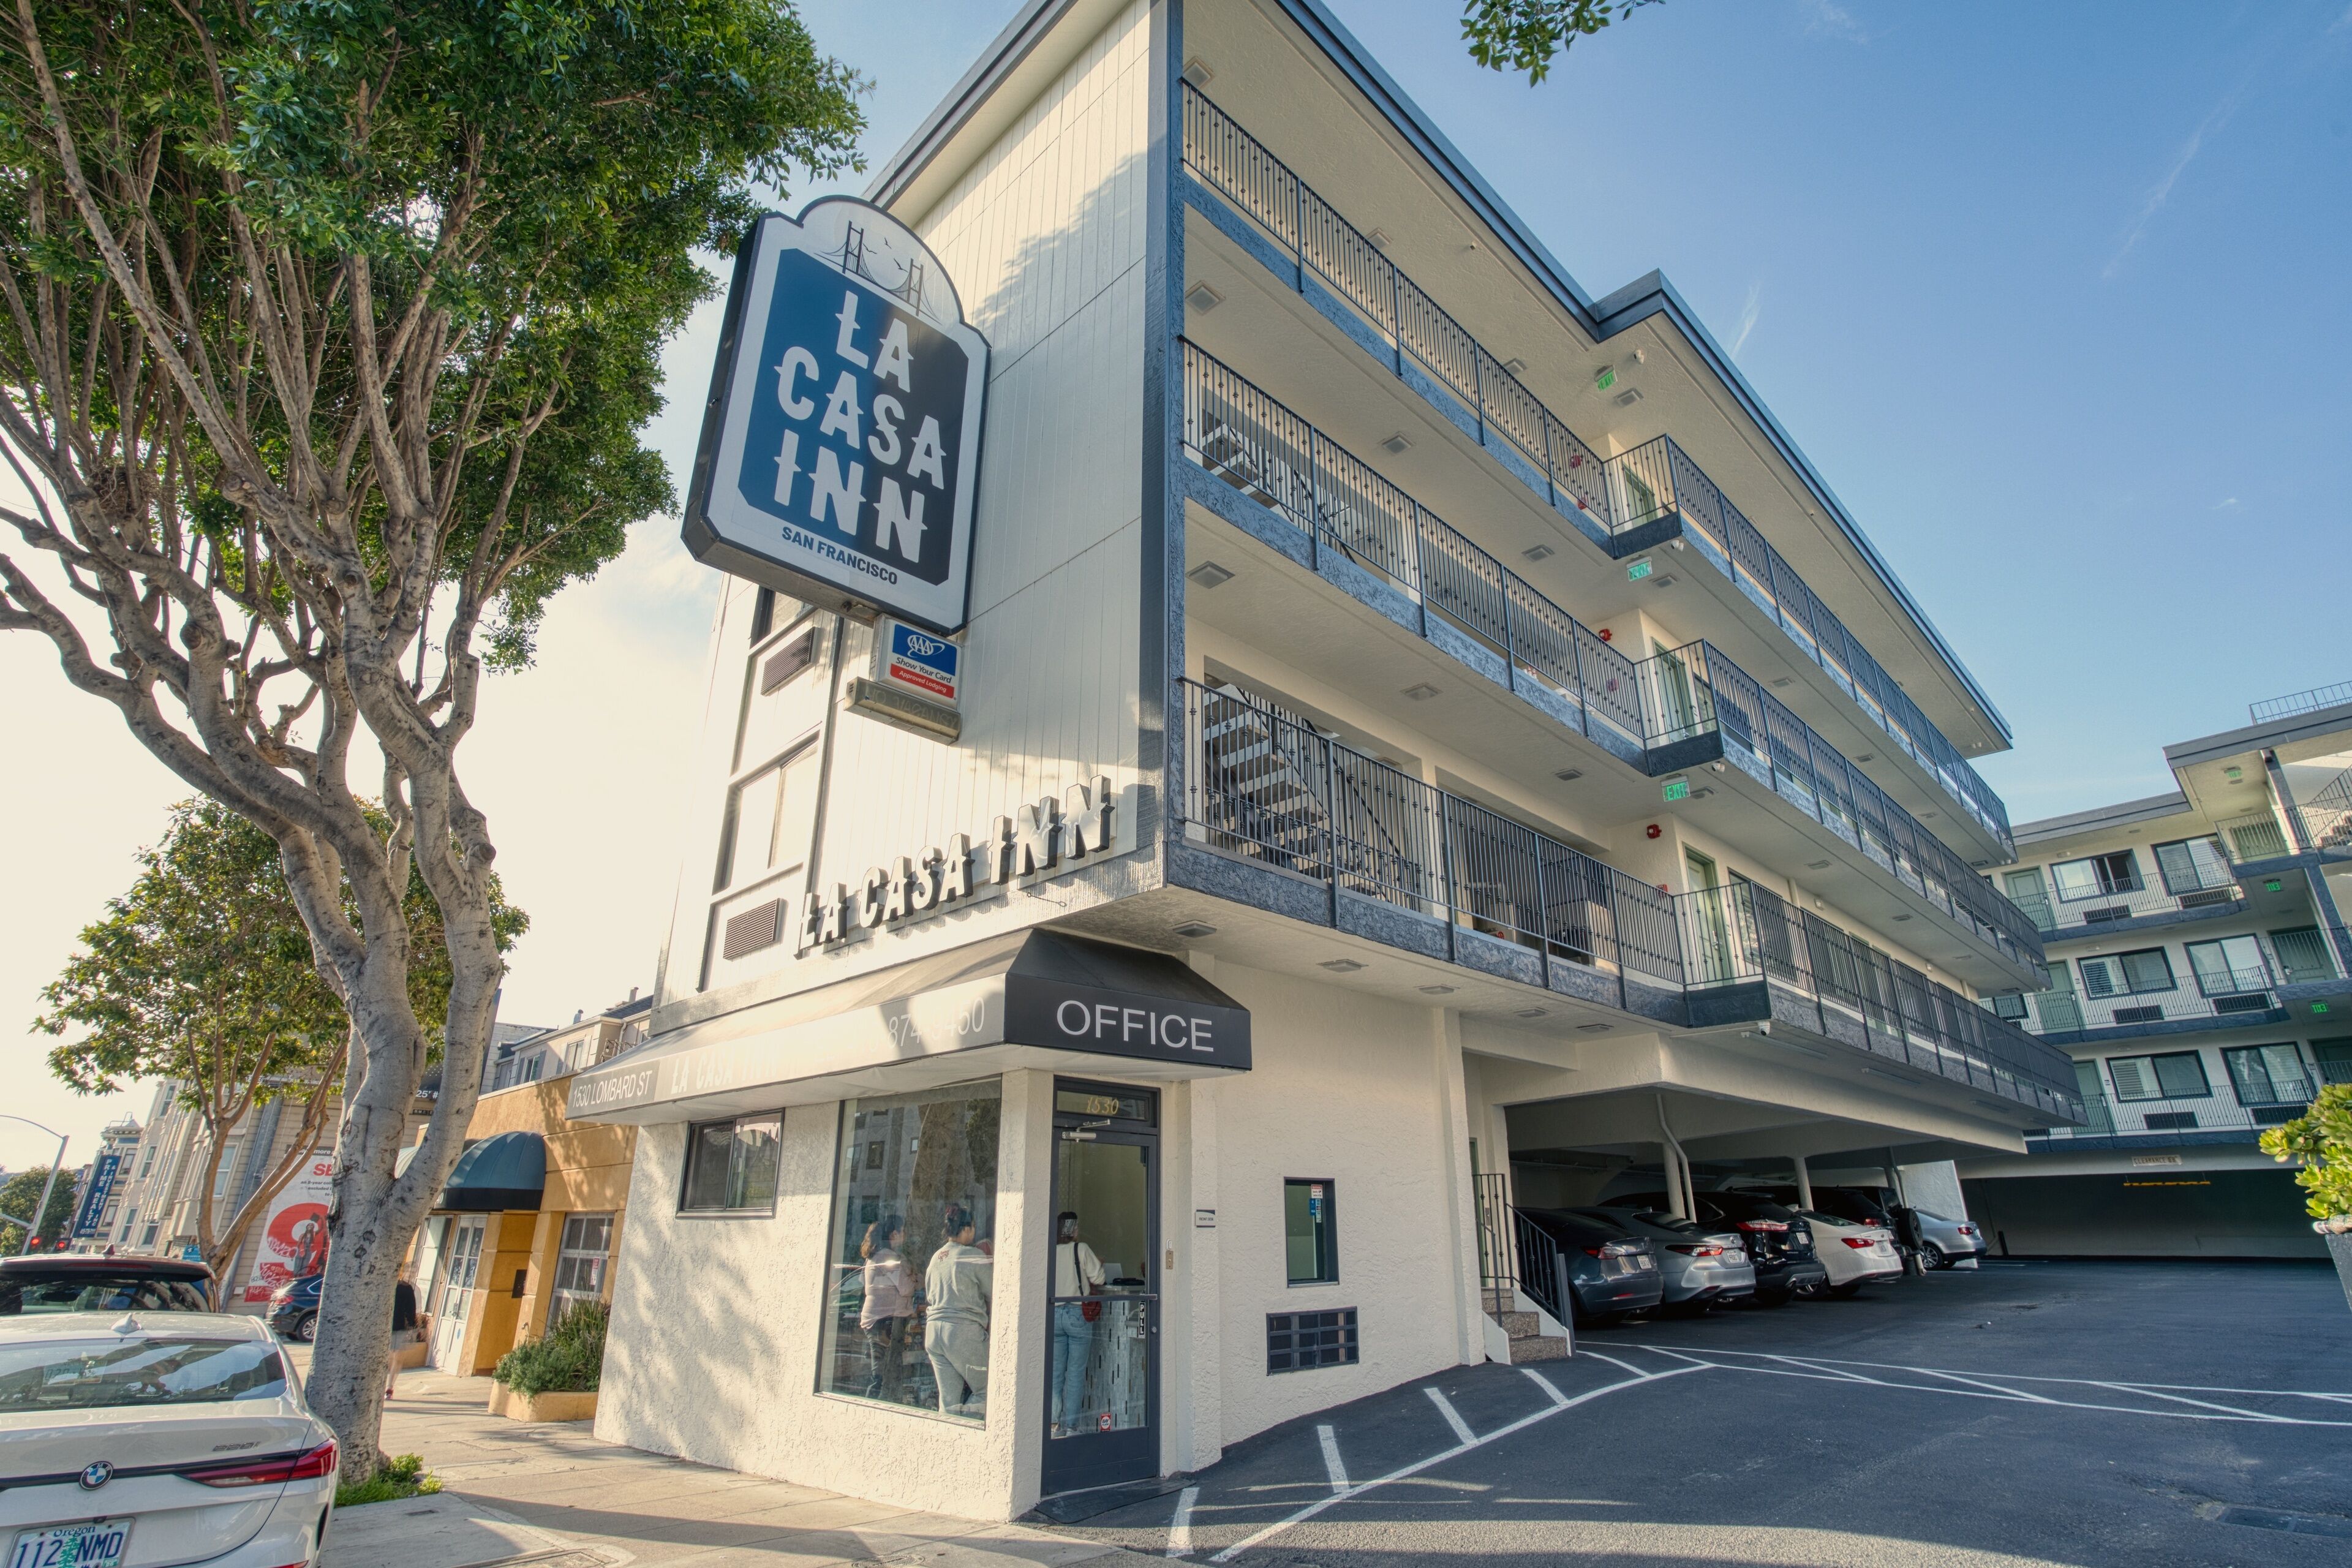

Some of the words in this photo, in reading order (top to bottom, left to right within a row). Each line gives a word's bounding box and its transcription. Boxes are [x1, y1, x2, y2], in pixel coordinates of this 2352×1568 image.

[835, 290, 914, 393] LA
[774, 346, 946, 489] CASA
[774, 429, 928, 563] INN
[782, 526, 815, 550] SAN
[817, 541, 898, 585] FRANCISCO
[908, 635, 933, 656] AAA
[895, 657, 918, 670] Show
[919, 665, 934, 677] Your
[935, 672, 952, 684] Card
[899, 670, 925, 685] Approved
[926, 679, 947, 693] Lodging
[865, 685, 887, 704] NO
[895, 695, 957, 727] VACANCY
[1666, 783, 1686, 801] EXIT
[799, 881, 850, 951] LA
[858, 832, 976, 929] CASA
[987, 774, 1115, 886] INN
[1057, 1000, 1214, 1052] OFFICE
[573, 1082, 590, 1108] 1530
[590, 1077, 635, 1105] LOMBARD
[636, 1070, 652, 1095] ST
[671, 1061, 690, 1094] LA
[695, 1051, 734, 1090] CASA
[1087, 1096, 1119, 1115] 1530
[98, 1171, 113, 1210] INVESTMENT
[99, 1159, 112, 1186] PRIME
[85, 1192, 101, 1226] REALTY
[15, 1539, 64, 1568] 112
[74, 1531, 123, 1562] NMD
[53, 1526, 96, 1537] Oregon
